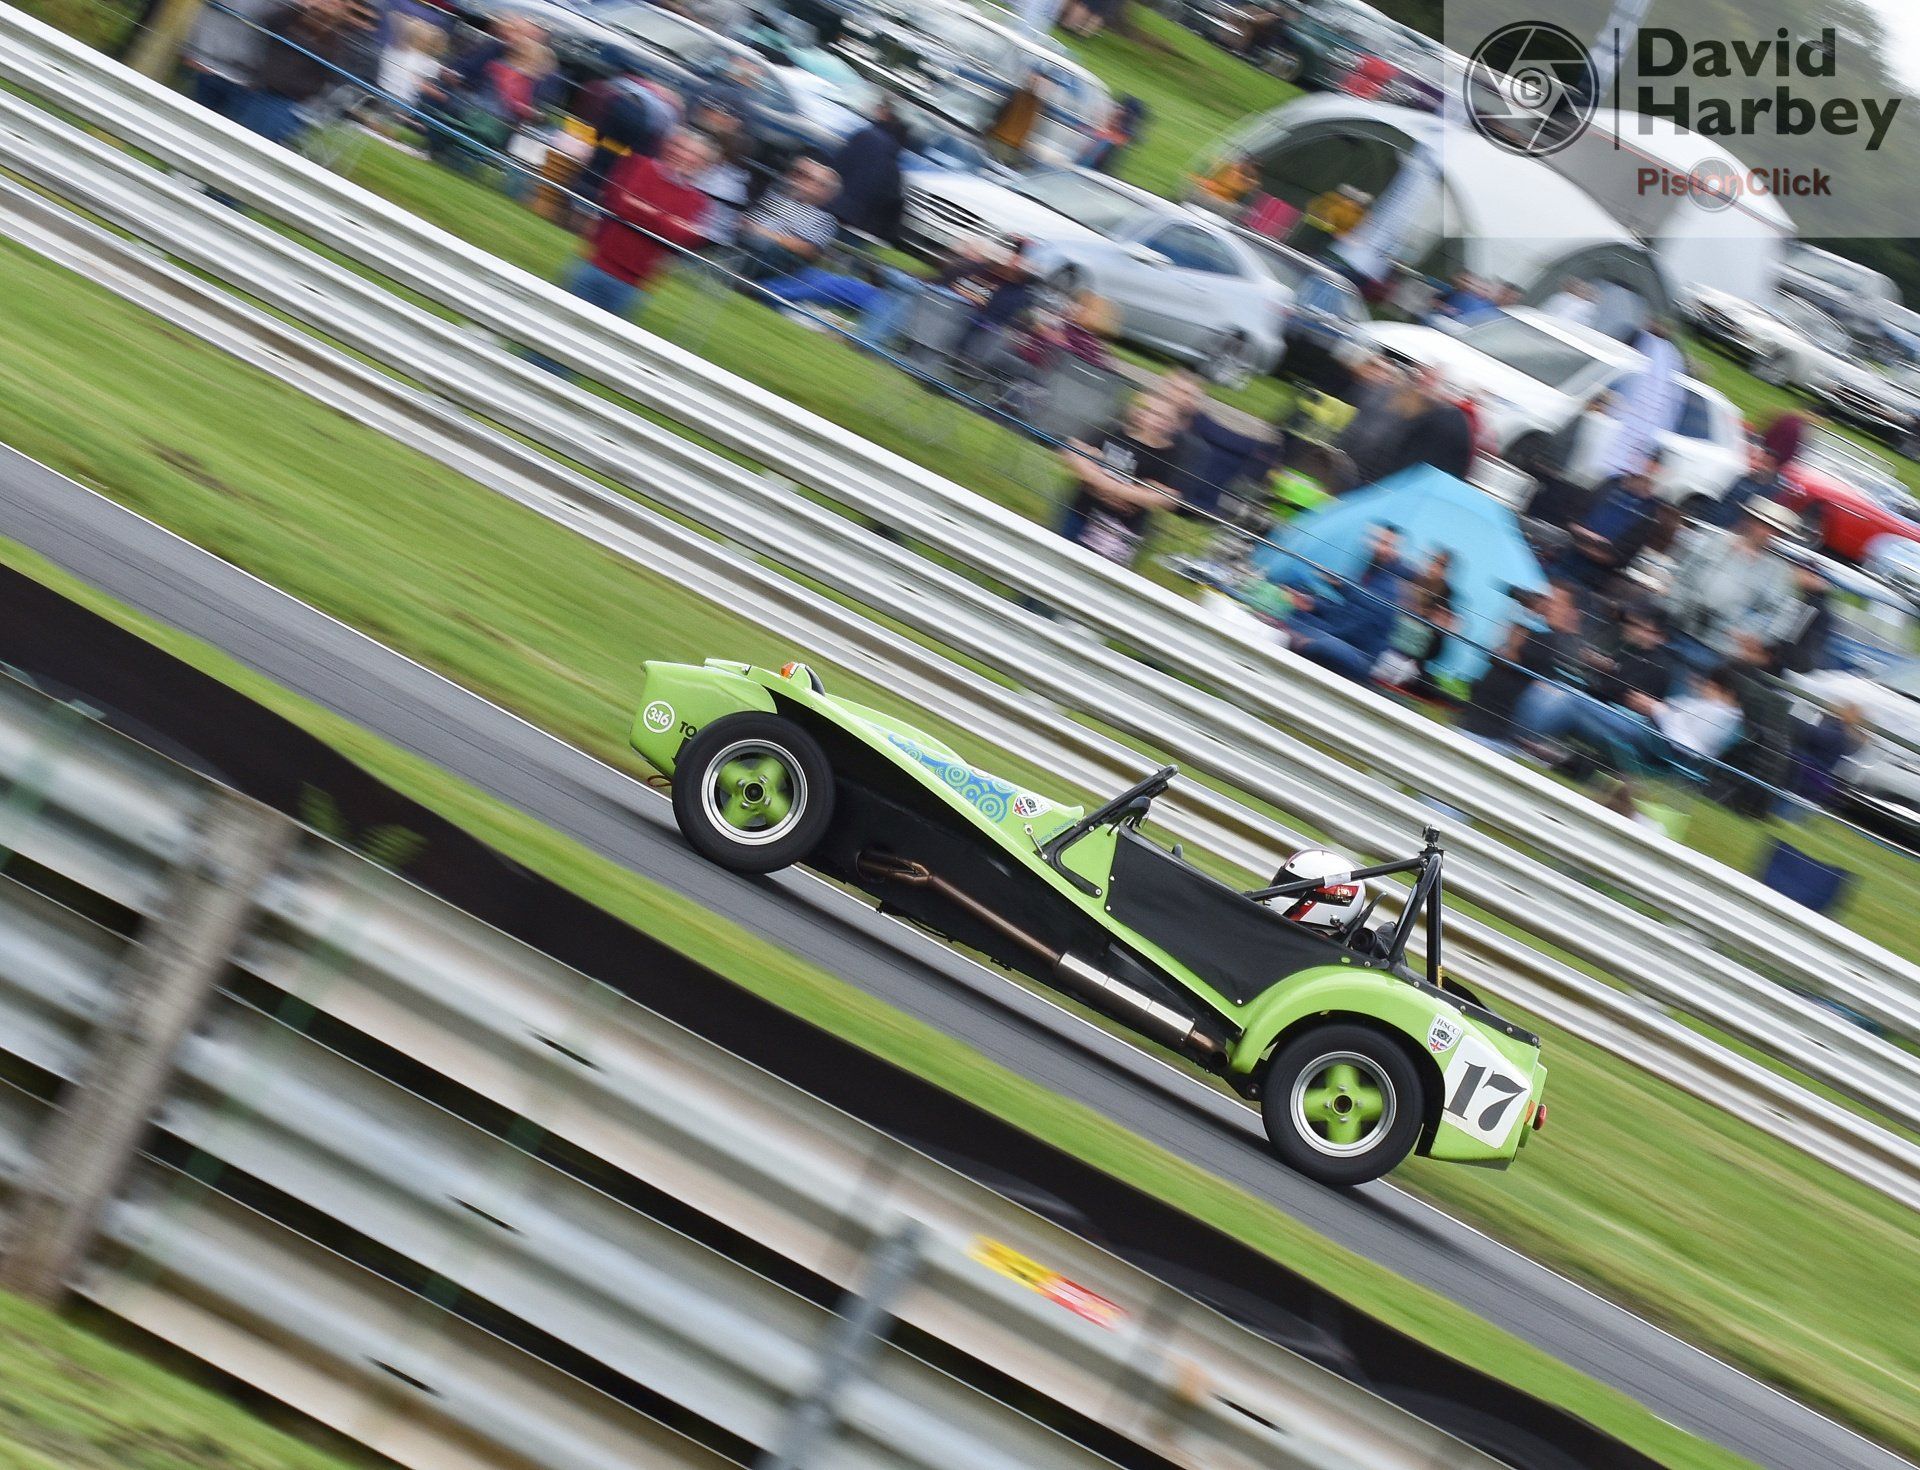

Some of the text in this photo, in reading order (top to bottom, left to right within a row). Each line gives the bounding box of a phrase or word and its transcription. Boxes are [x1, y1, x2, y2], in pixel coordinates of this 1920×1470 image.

[680, 721, 698, 737] TO
[1437, 1019, 1460, 1035] HSCC
[1444, 1061, 1527, 1131] 17
